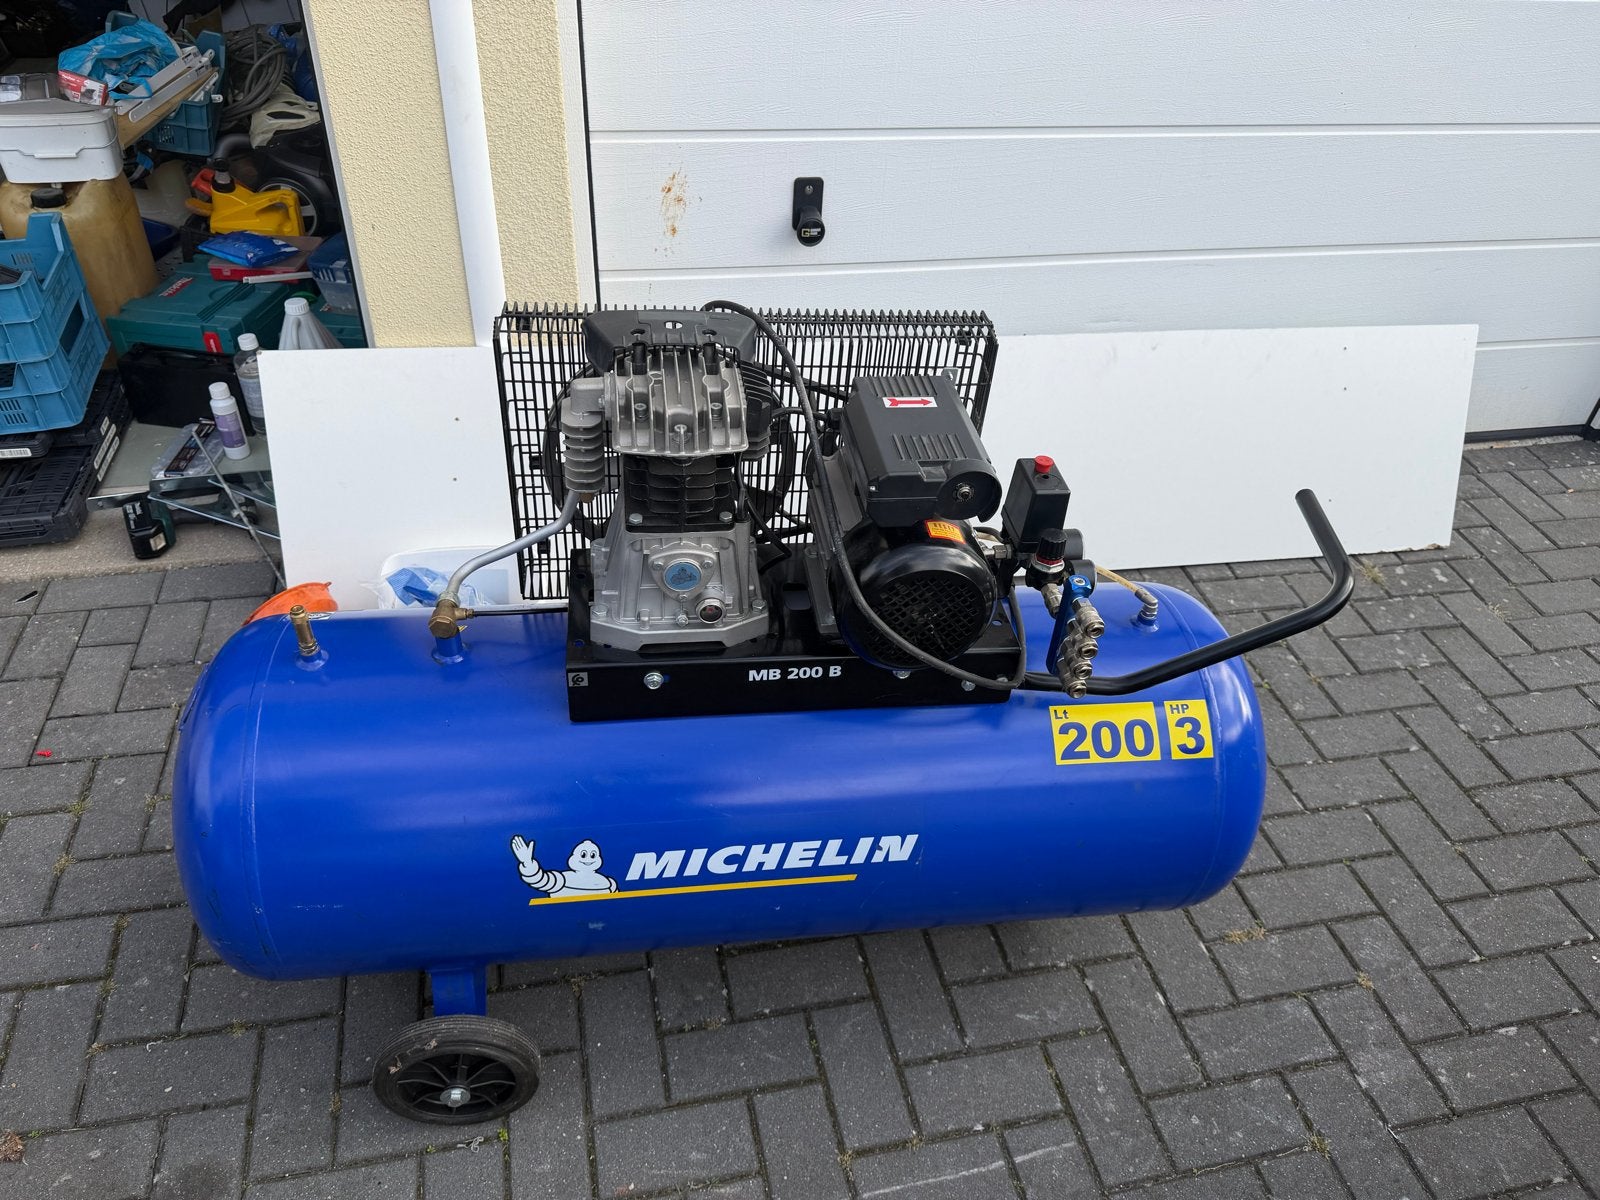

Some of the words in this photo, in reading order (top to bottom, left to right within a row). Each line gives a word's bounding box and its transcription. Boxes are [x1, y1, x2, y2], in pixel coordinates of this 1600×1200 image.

[748, 669, 782, 682] MB
[787, 666, 824, 680] 200
[828, 665, 842, 677] B
[1053, 708, 1070, 720] Lt
[1169, 703, 1190, 715] HP
[1058, 718, 1155, 761] 200
[1174, 716, 1206, 755] 3
[625, 834, 919, 881] MICHELIN
